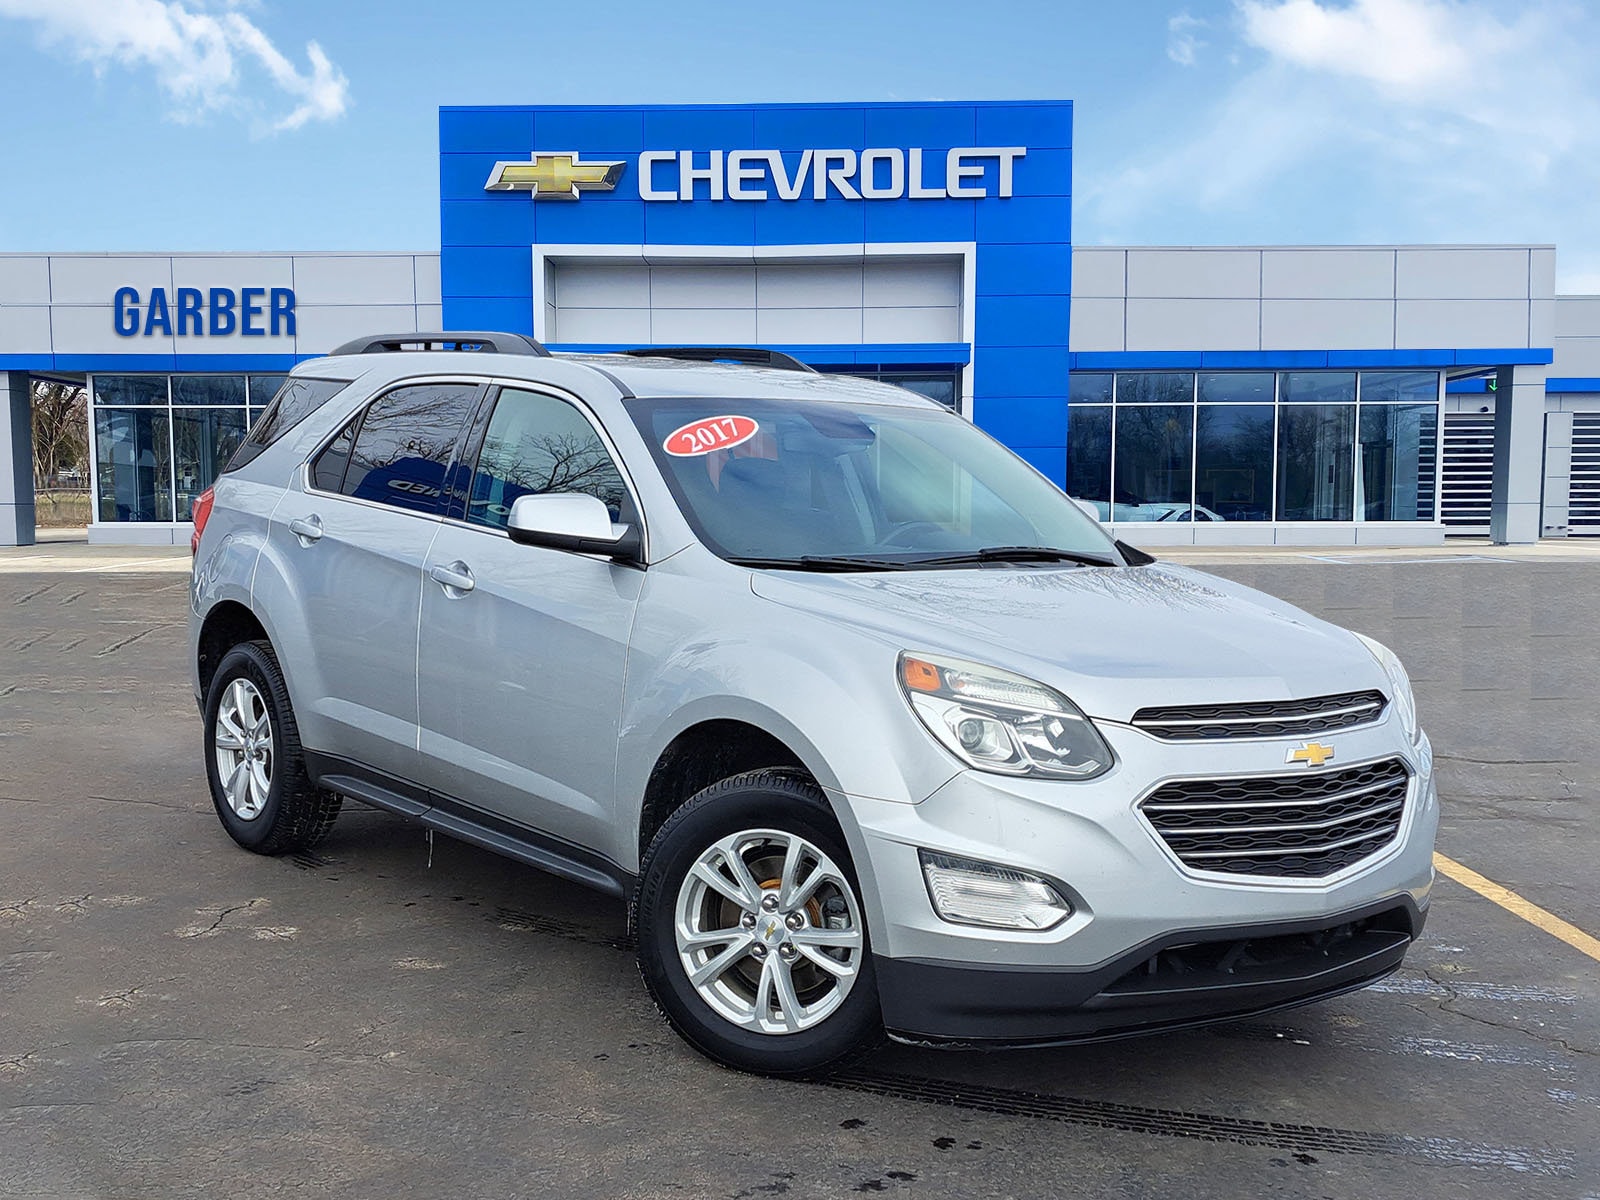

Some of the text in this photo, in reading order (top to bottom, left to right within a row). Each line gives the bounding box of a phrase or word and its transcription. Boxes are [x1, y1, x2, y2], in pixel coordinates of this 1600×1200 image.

[638, 147, 1026, 201] CHEVROLET
[114, 286, 296, 336] GARBER
[681, 417, 738, 452] 2017
